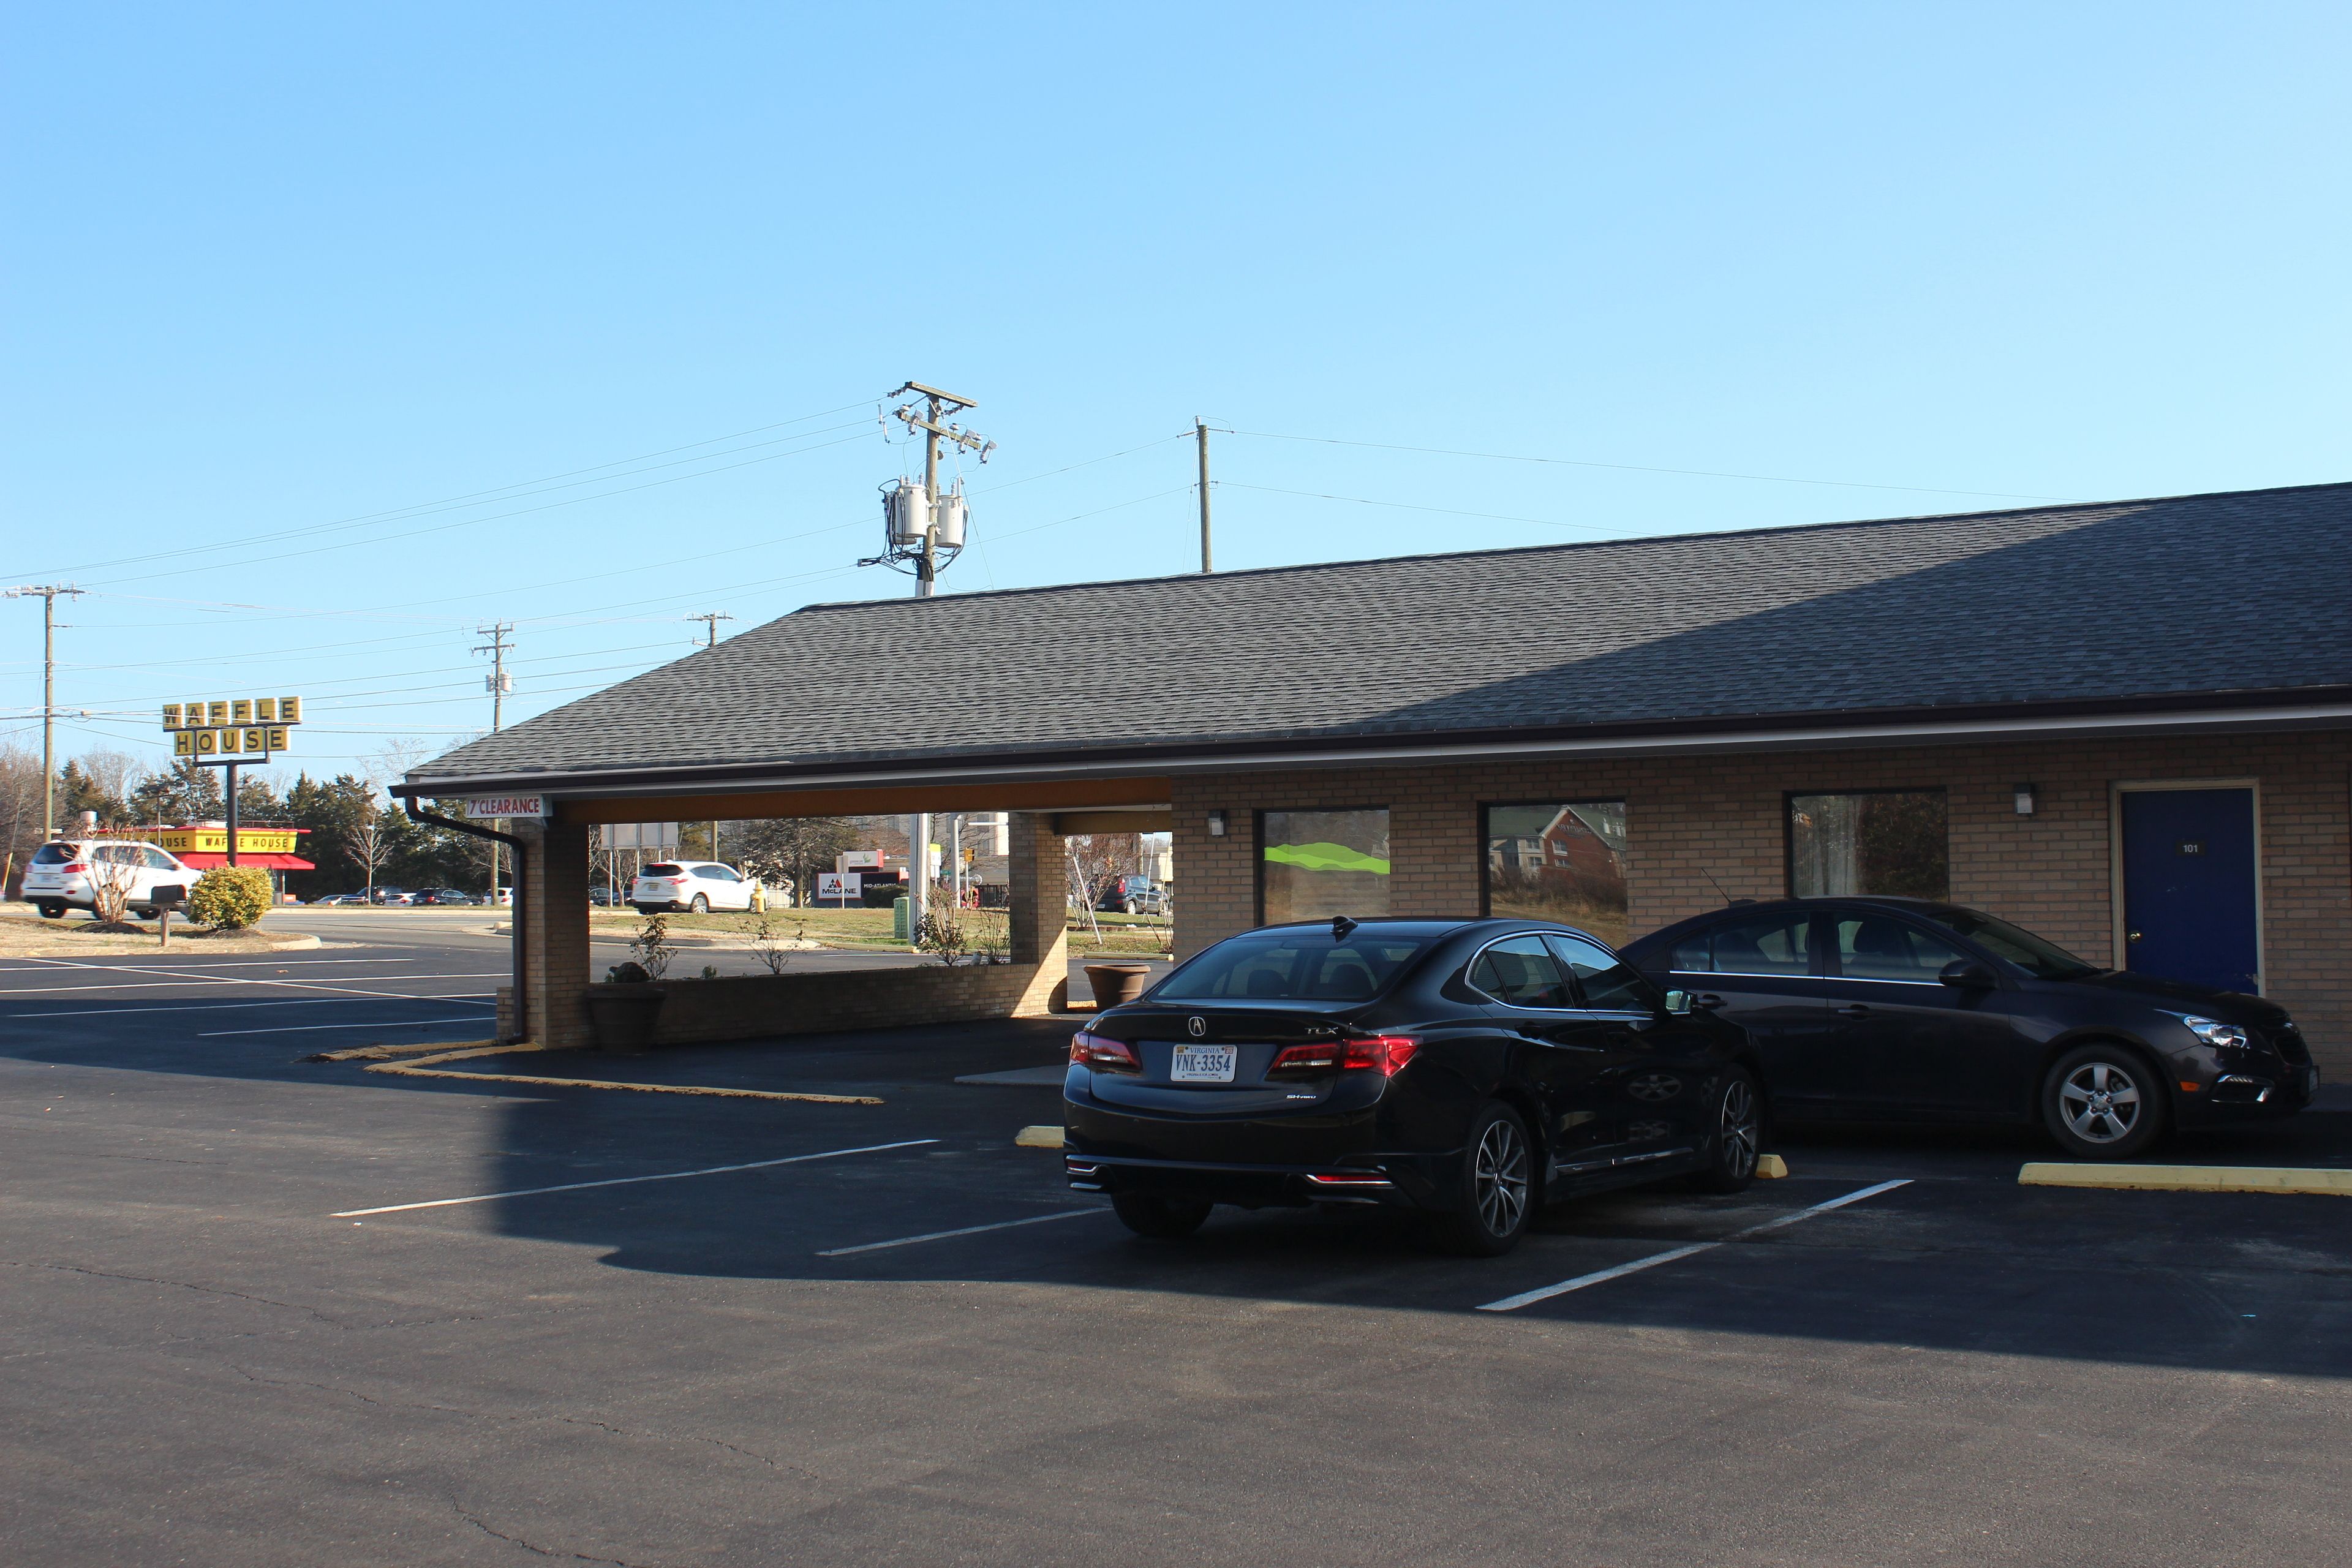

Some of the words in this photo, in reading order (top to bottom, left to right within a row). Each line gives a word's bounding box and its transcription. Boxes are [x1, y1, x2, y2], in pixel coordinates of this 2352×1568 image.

[164, 701, 295, 724] WAFFLE
[177, 729, 282, 752] HOUSE
[206, 837, 245, 847] WAFE
[253, 838, 288, 848] HOUSE
[1176, 1054, 1231, 1071] VNK-3354
